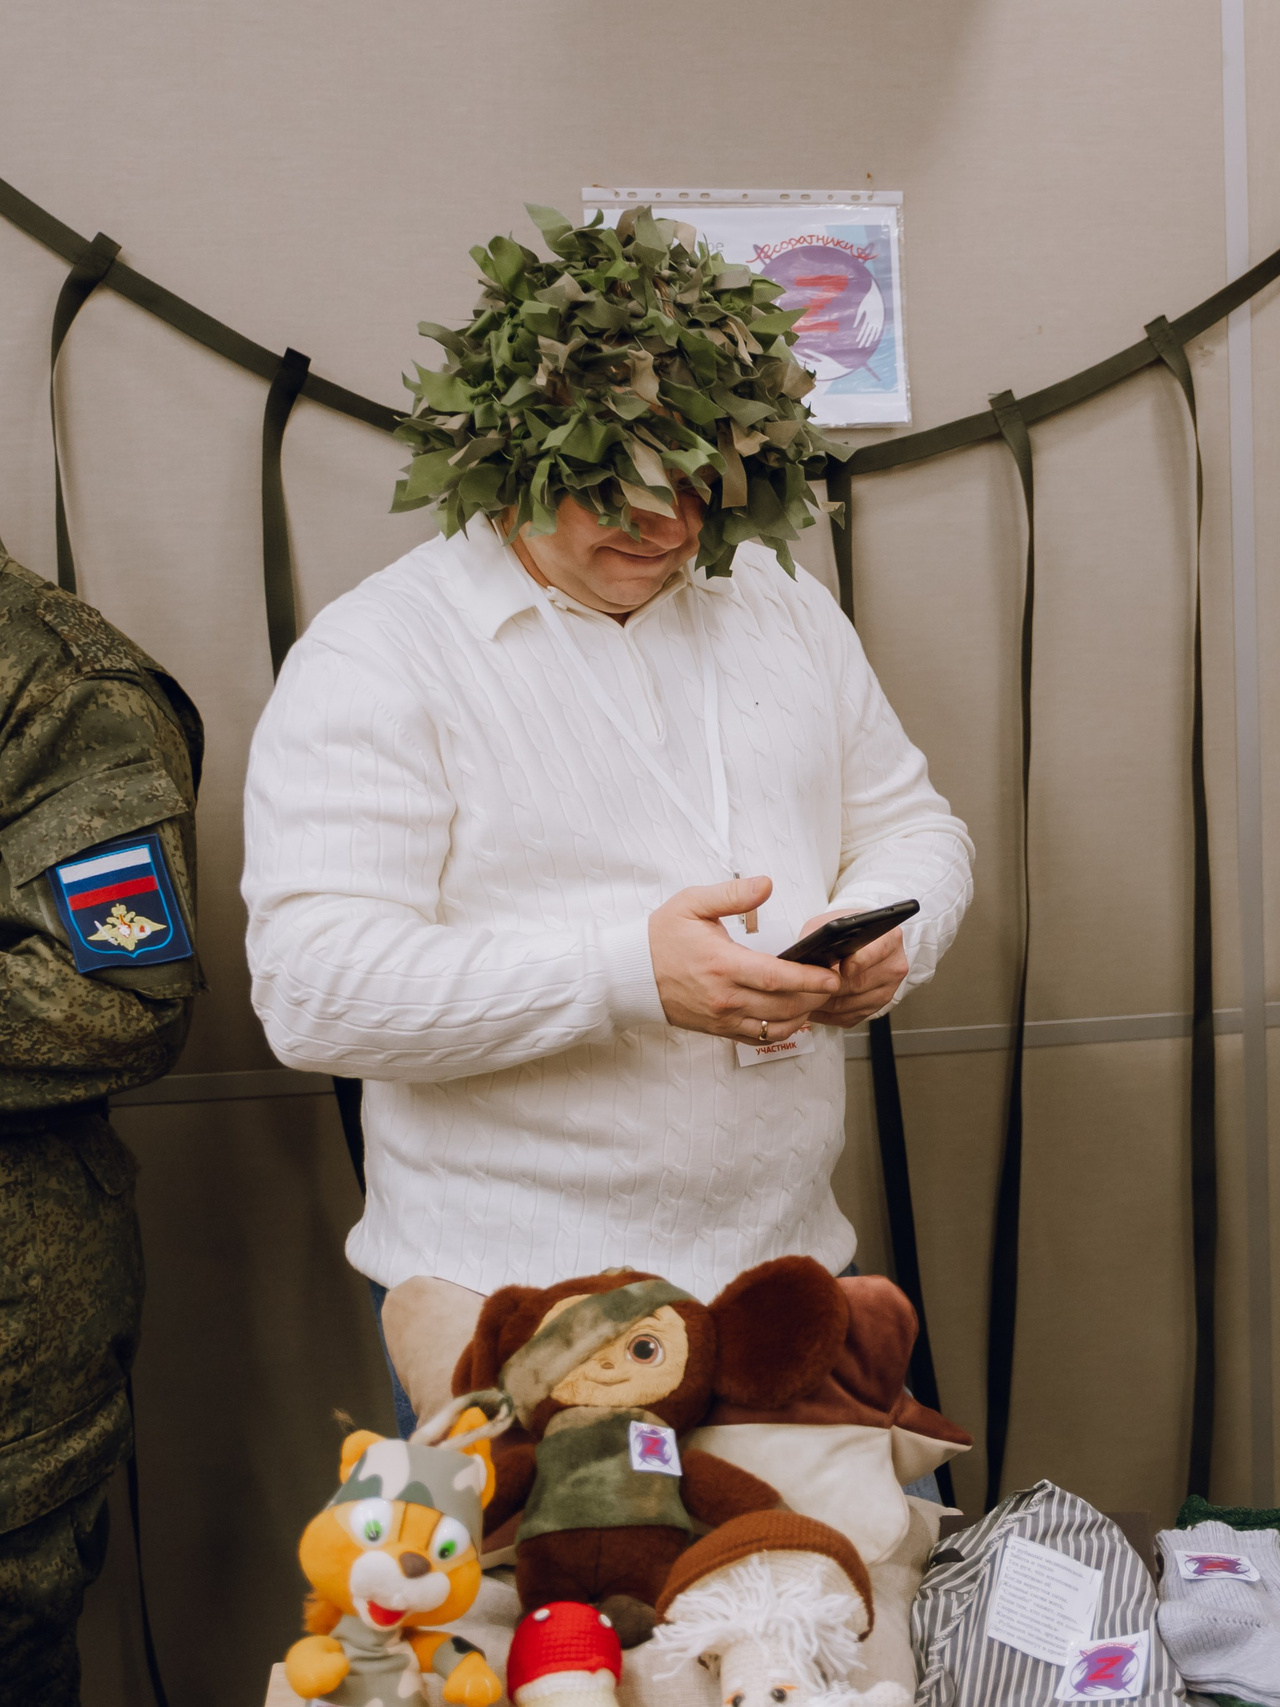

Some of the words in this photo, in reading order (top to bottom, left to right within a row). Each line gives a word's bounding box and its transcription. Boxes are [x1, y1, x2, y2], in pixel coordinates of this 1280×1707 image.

[792, 275, 848, 332] Z
[755, 1041, 797, 1055] УЧАСТНИК
[644, 1437, 661, 1456] Z
[1087, 1655, 1124, 1681] Z
